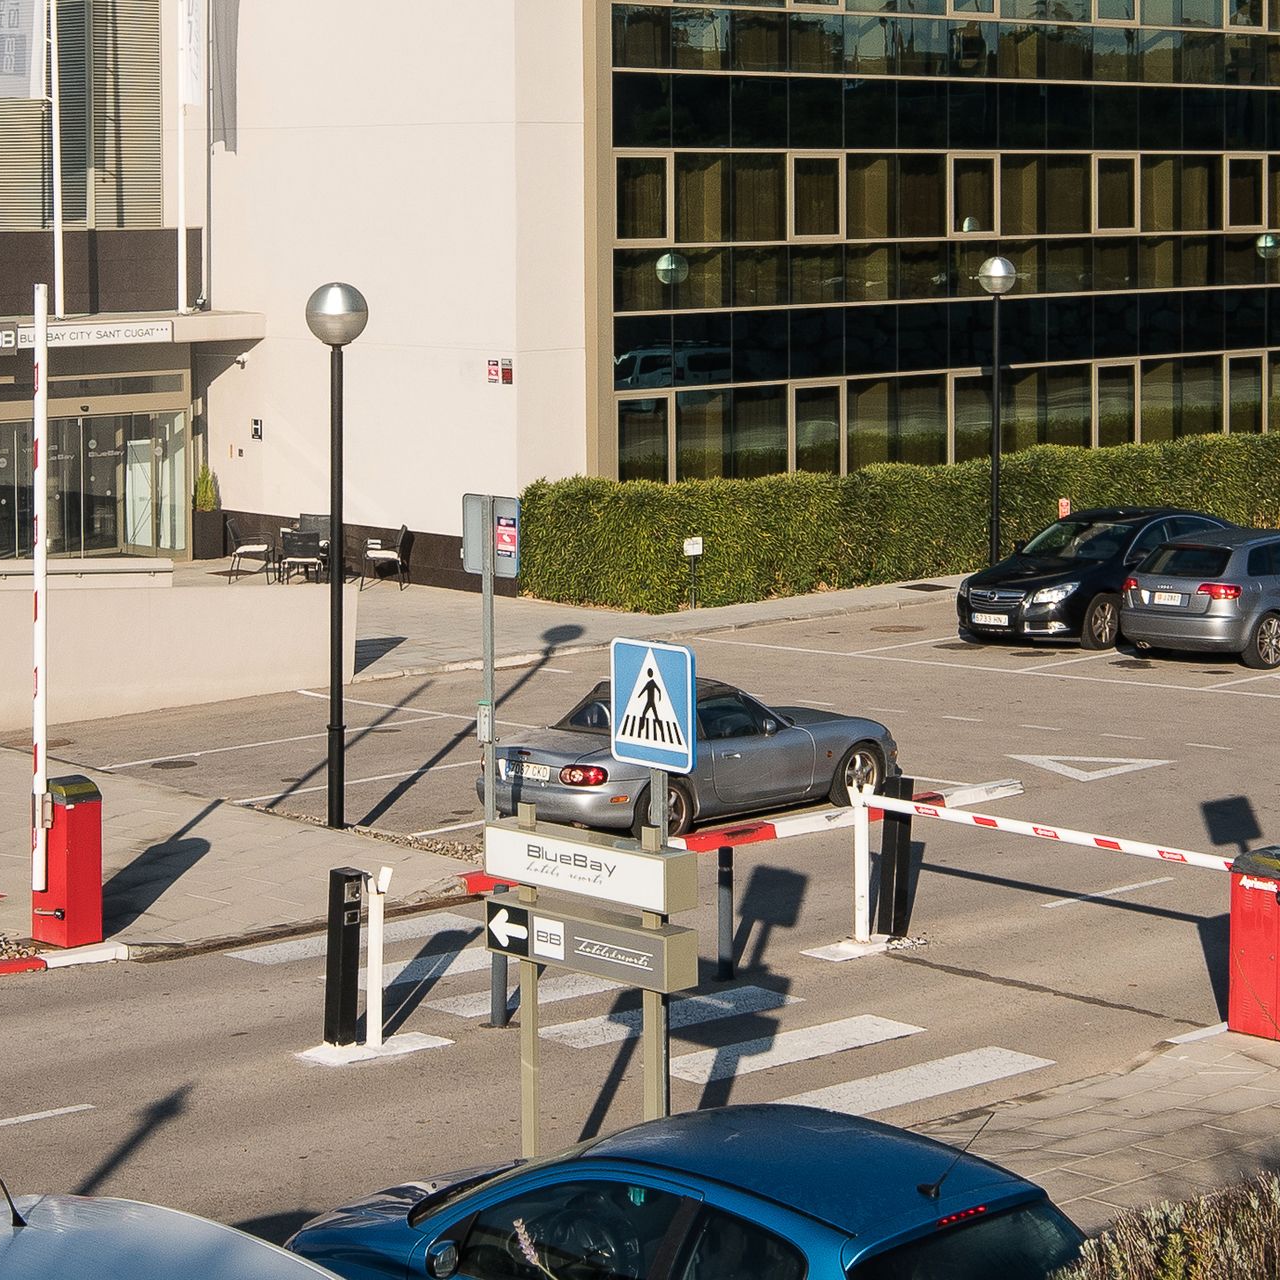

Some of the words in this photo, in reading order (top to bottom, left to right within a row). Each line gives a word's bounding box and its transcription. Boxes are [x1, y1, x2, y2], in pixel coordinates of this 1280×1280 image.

[69, 330, 93, 341] CITY
[95, 329, 121, 340] SANT
[526, 844, 617, 878] BlueBay
[536, 930, 562, 946] BB
